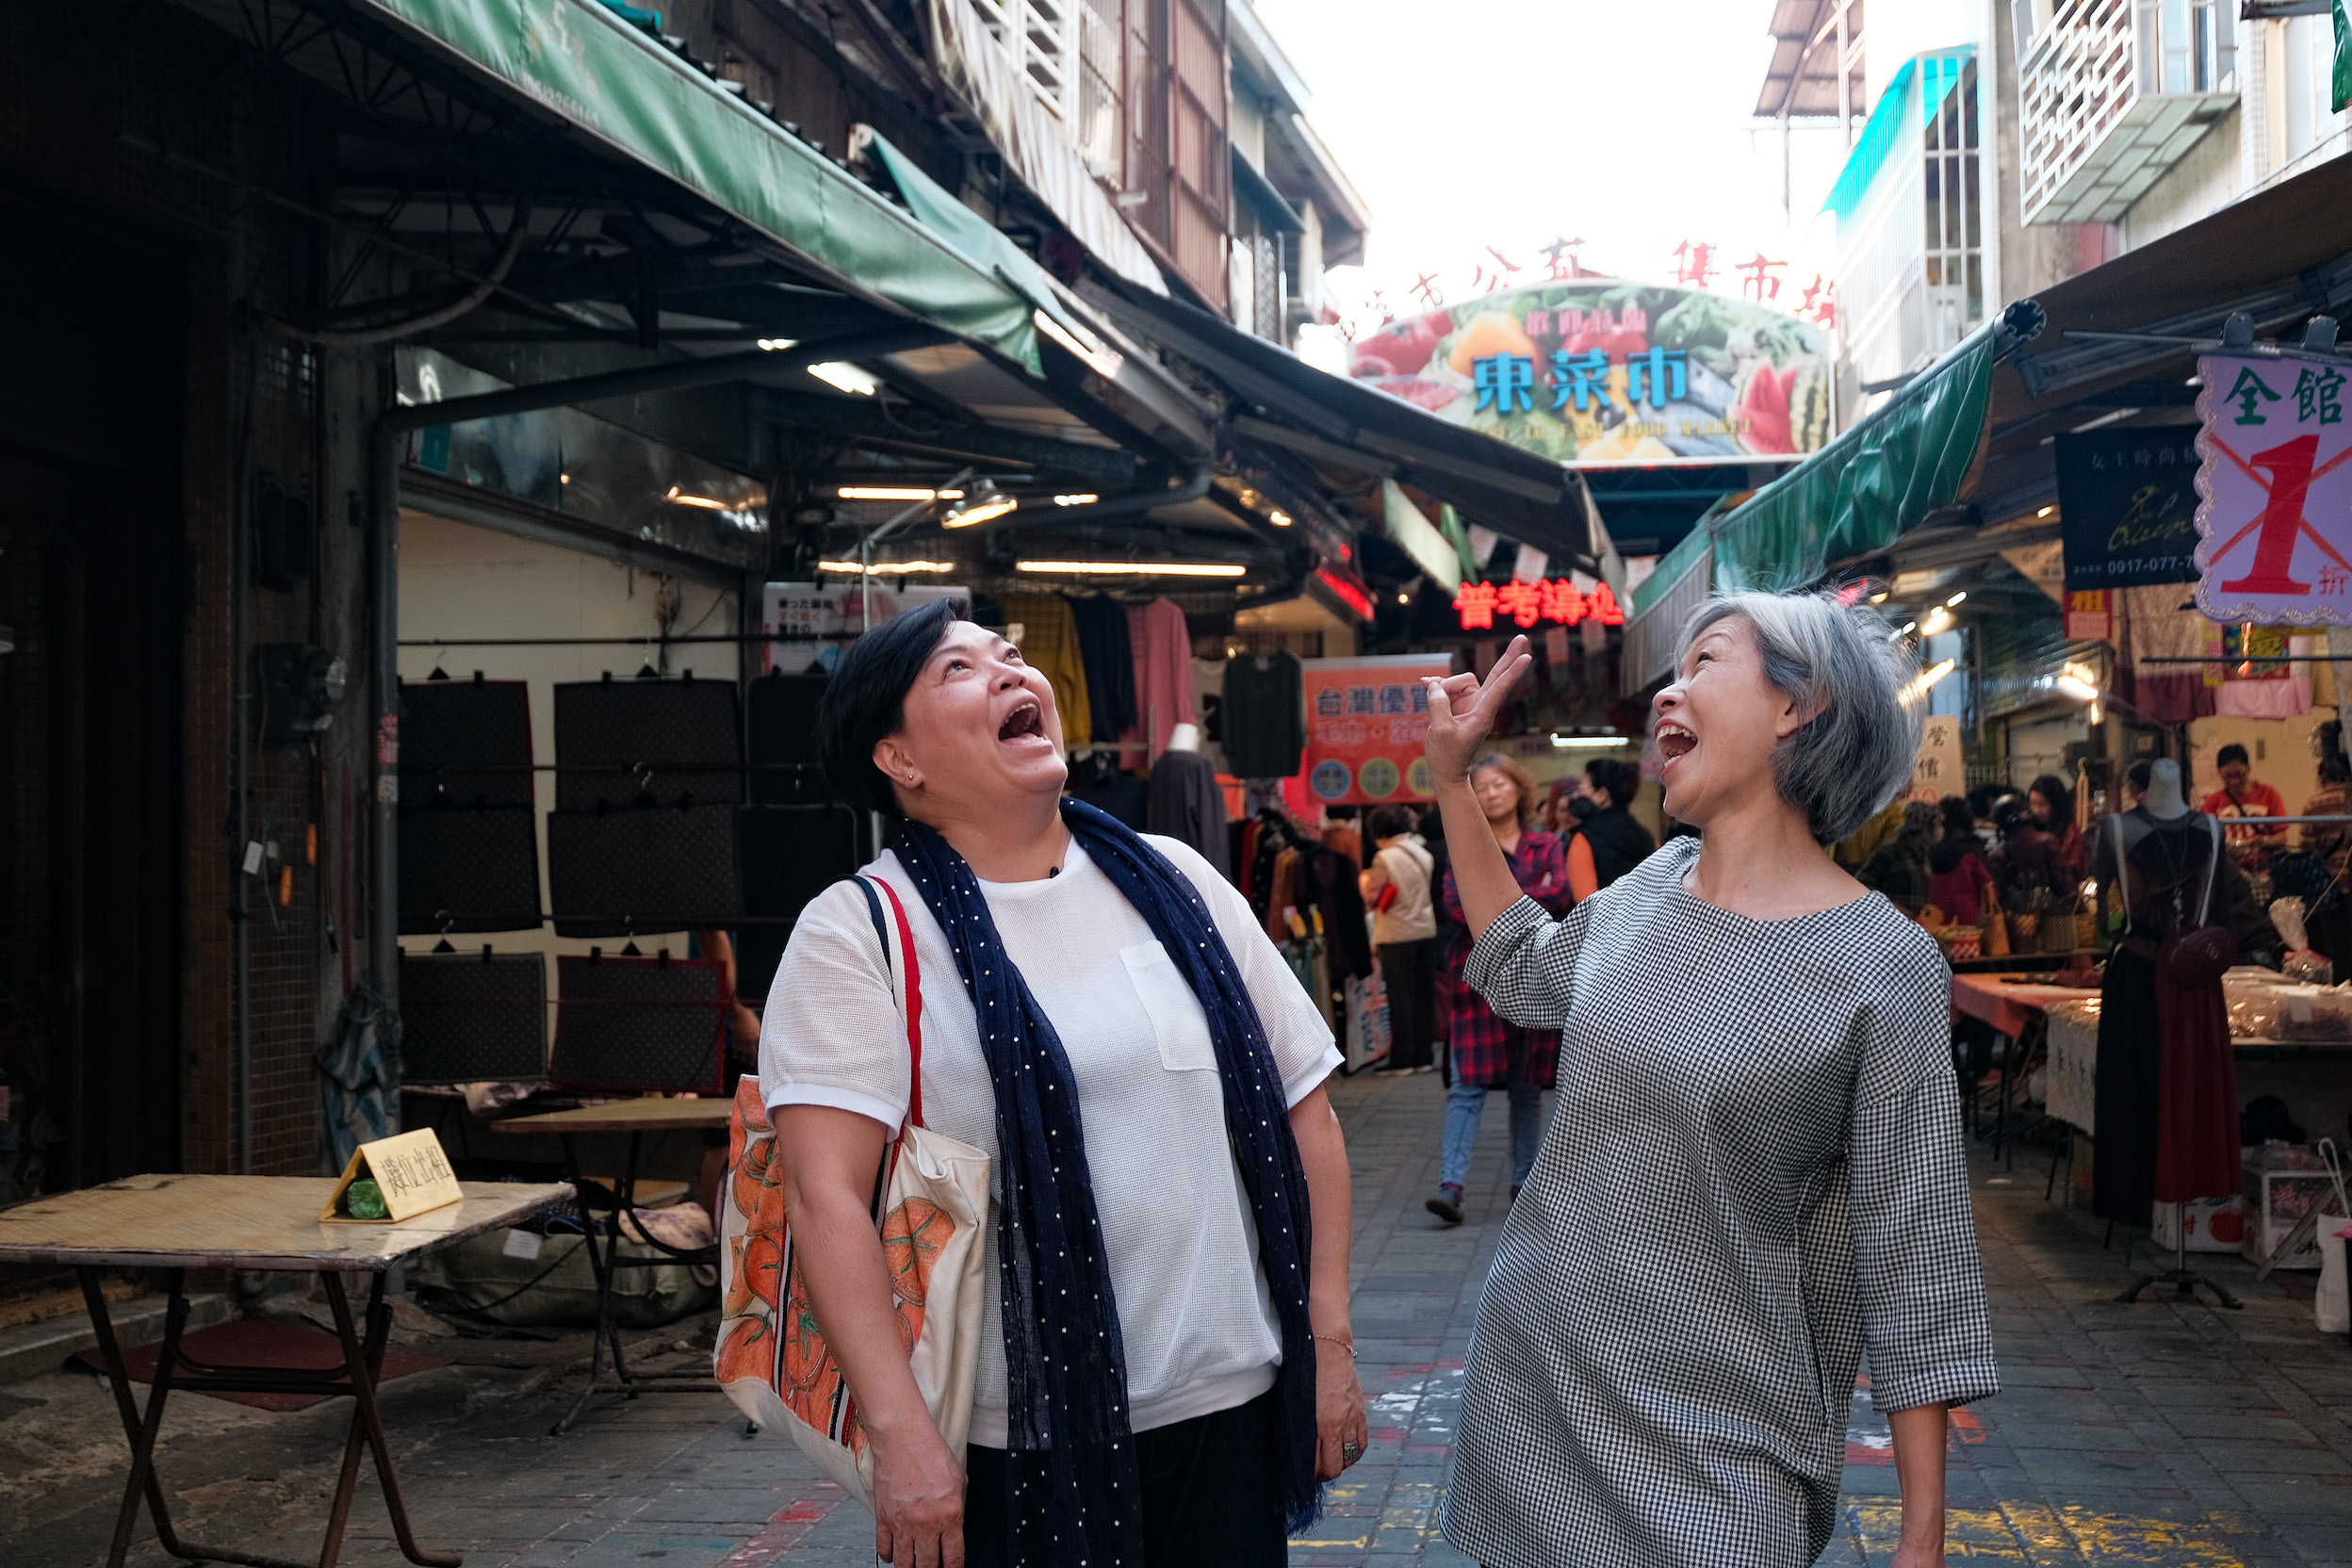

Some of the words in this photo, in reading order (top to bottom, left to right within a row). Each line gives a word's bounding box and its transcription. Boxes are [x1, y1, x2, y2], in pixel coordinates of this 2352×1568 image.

[1473, 345, 1688, 413] 東菜市
[2223, 366, 2347, 426] 全館
[1560, 422, 1604, 440] EAST
[1620, 420, 1666, 438] FOOD
[1681, 417, 1752, 437] MARKET
[2219, 434, 2320, 596] 1
[2319, 565, 2349, 596] 折
